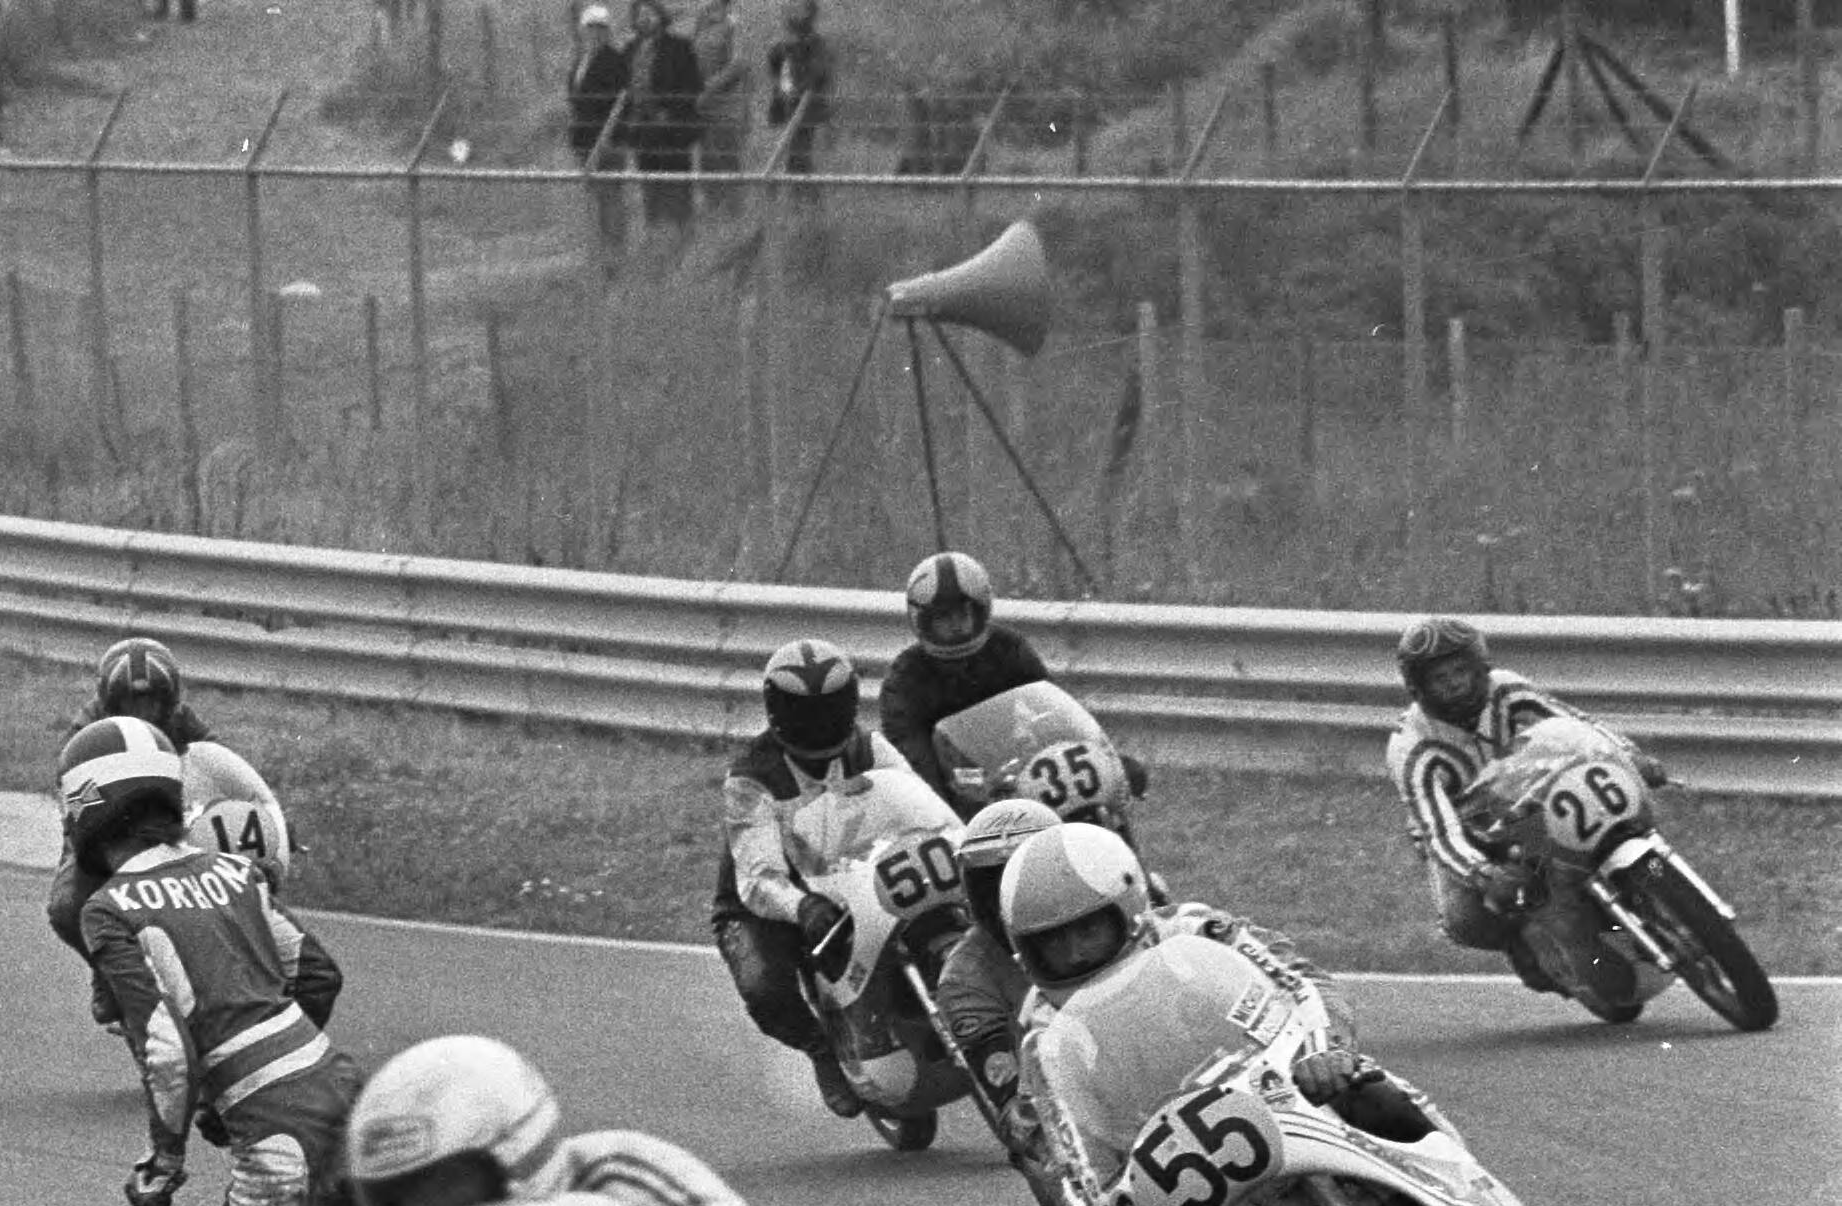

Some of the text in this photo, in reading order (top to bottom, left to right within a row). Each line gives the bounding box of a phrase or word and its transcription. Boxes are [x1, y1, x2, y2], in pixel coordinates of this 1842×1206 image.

[1031, 745, 1101, 808] 35
[1551, 766, 1629, 841] 26
[211, 810, 266, 857] 14
[876, 837, 960, 908] 50
